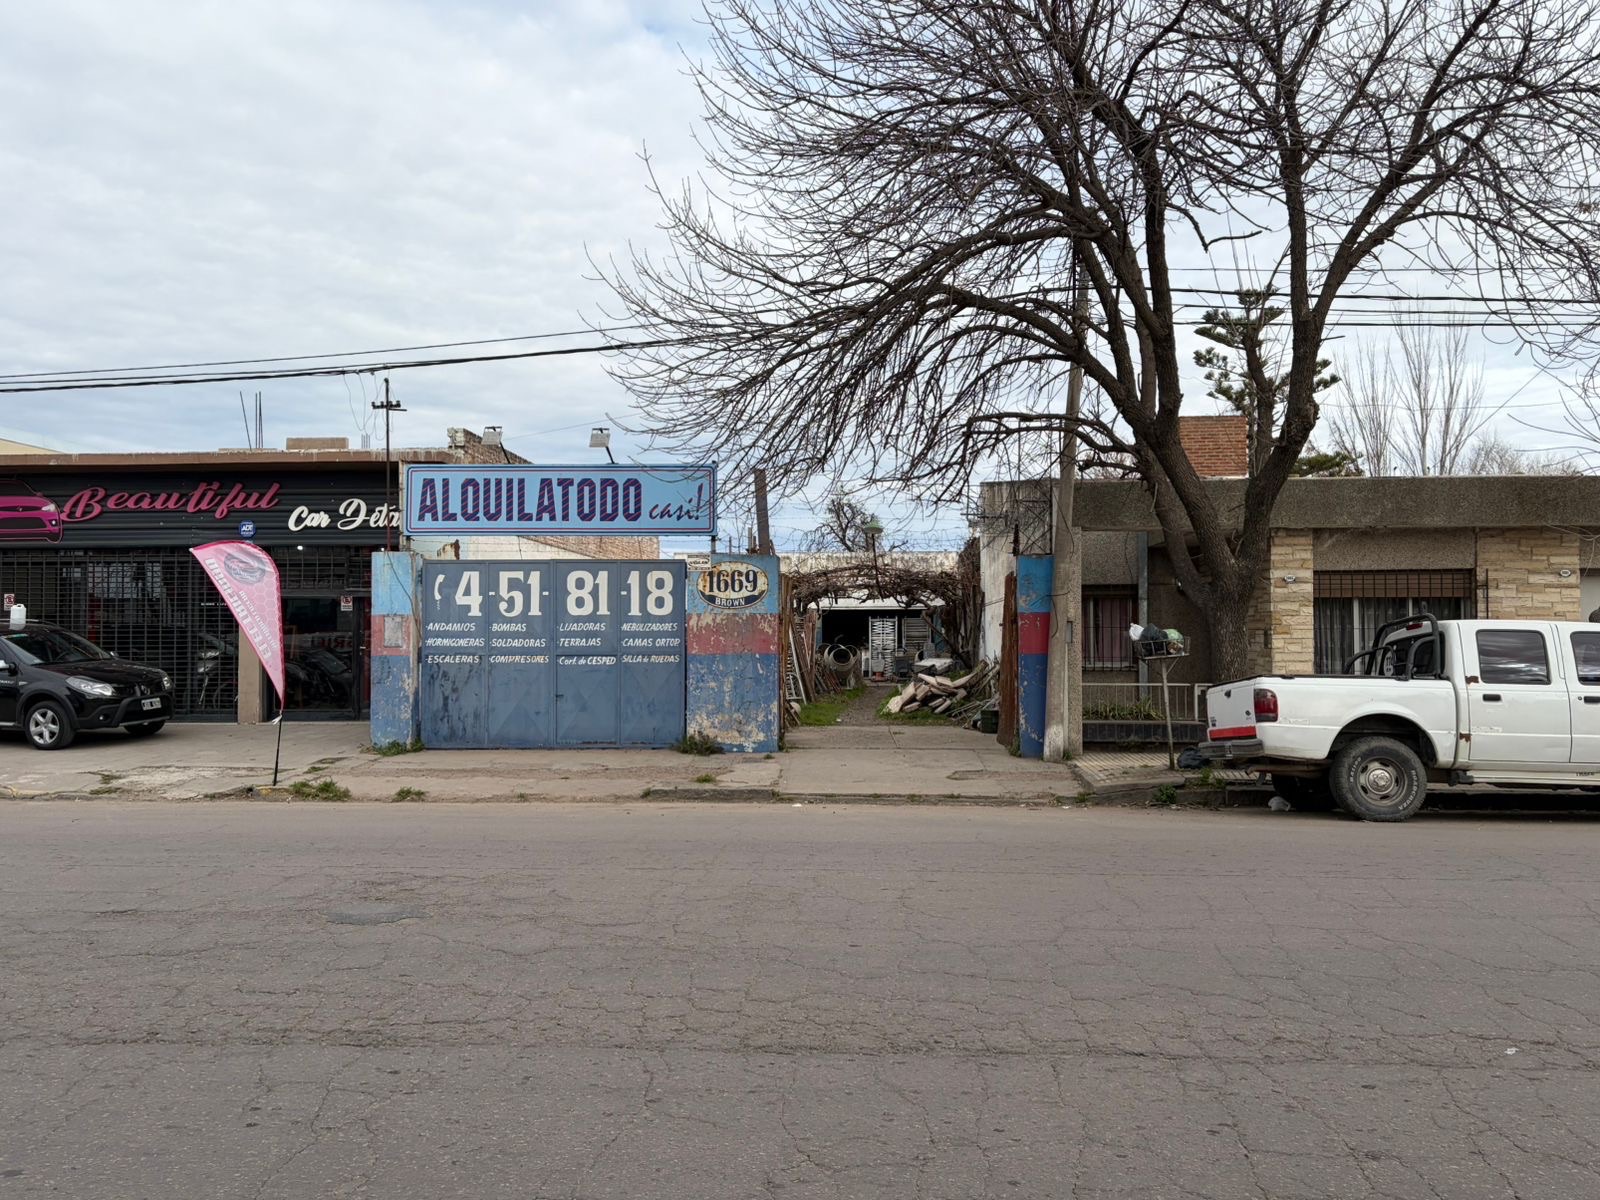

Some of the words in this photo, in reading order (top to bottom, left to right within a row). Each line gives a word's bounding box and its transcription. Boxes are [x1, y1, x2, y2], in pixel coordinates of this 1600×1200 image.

[60, 481, 280, 520] Beautiful
[417, 477, 642, 522] ALQUILATODO
[649, 483, 704, 521] casi!
[288, 505, 331, 531] Car
[707, 569, 758, 593] 1669
[715, 597, 745, 607] BROWN
